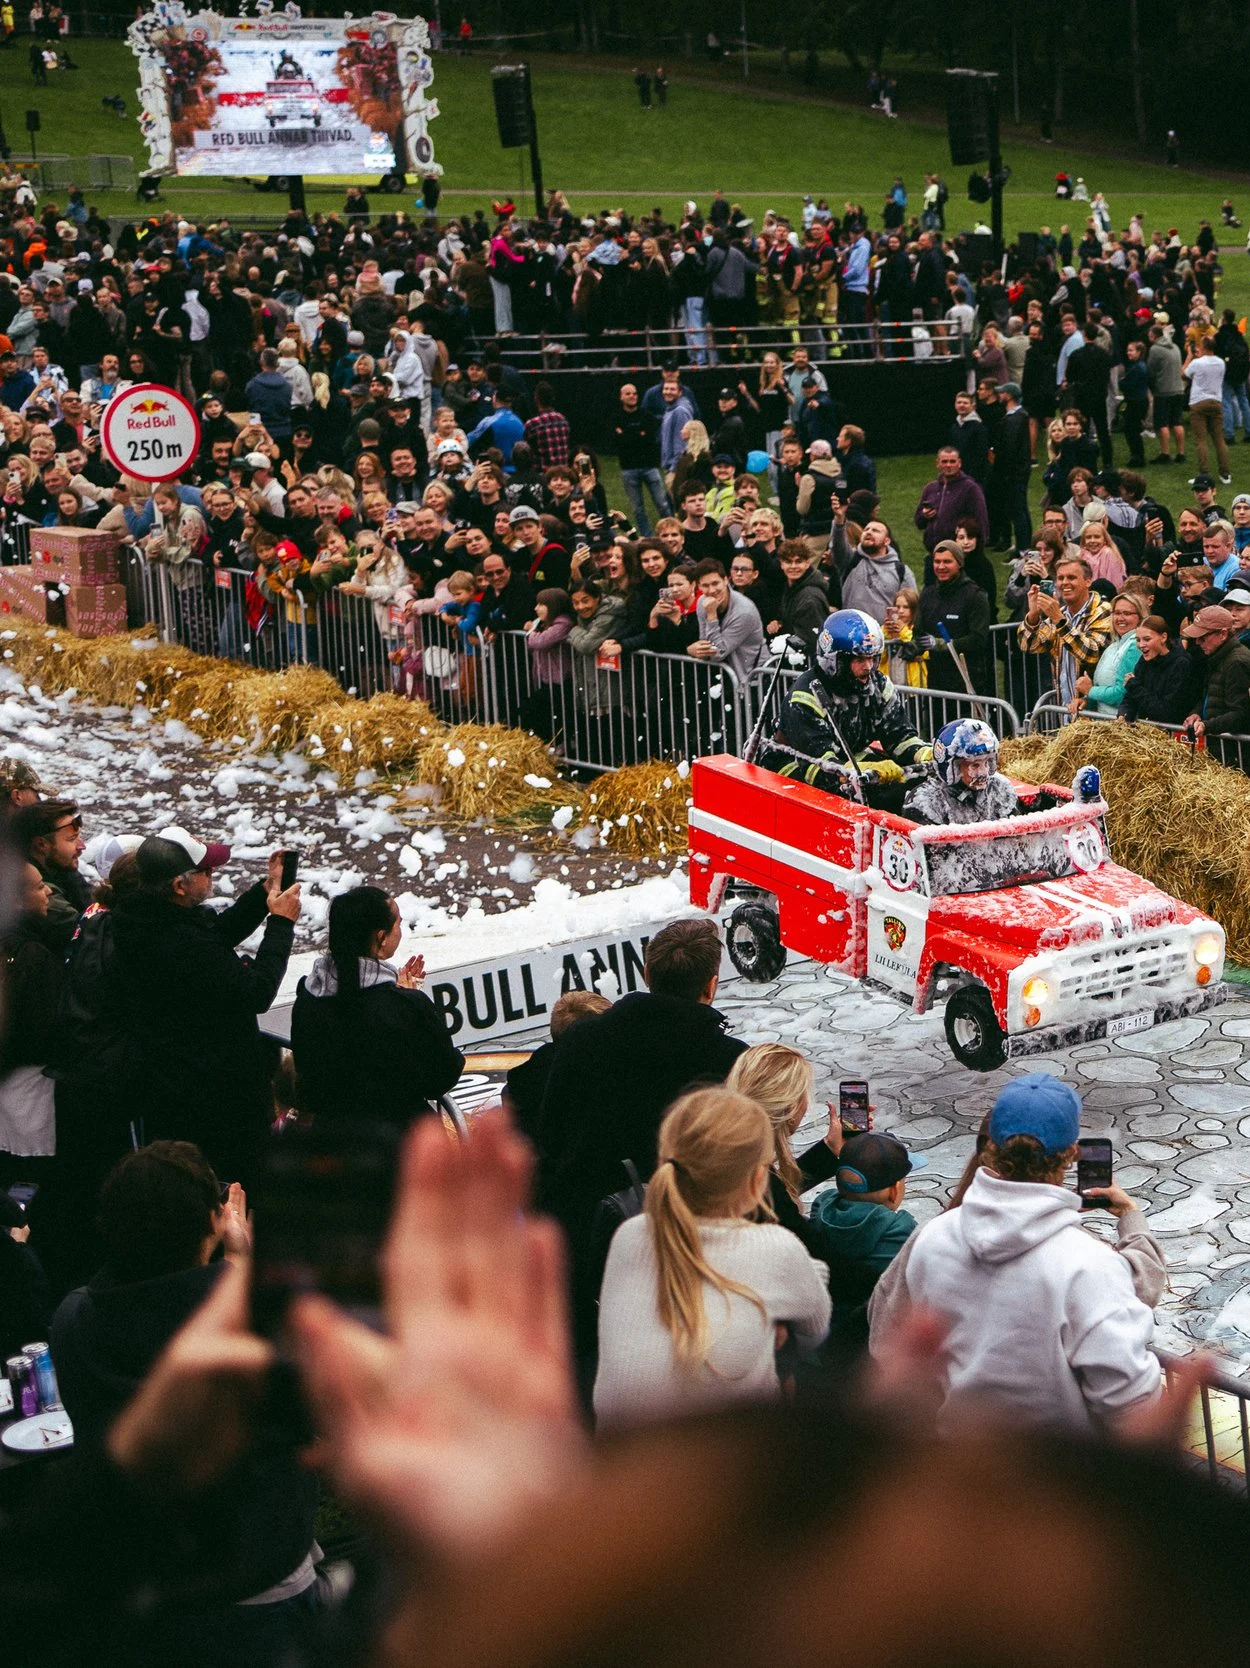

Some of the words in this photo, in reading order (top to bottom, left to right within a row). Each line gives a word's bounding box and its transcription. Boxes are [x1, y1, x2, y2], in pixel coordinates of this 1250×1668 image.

[238, 130, 265, 145] BULL
[127, 417, 152, 430] Red
[153, 414, 177, 428] Bull
[127, 438, 163, 462] 250
[166, 443, 183, 458] m
[889, 853, 909, 884] 30
[431, 963, 548, 1037] BULL
